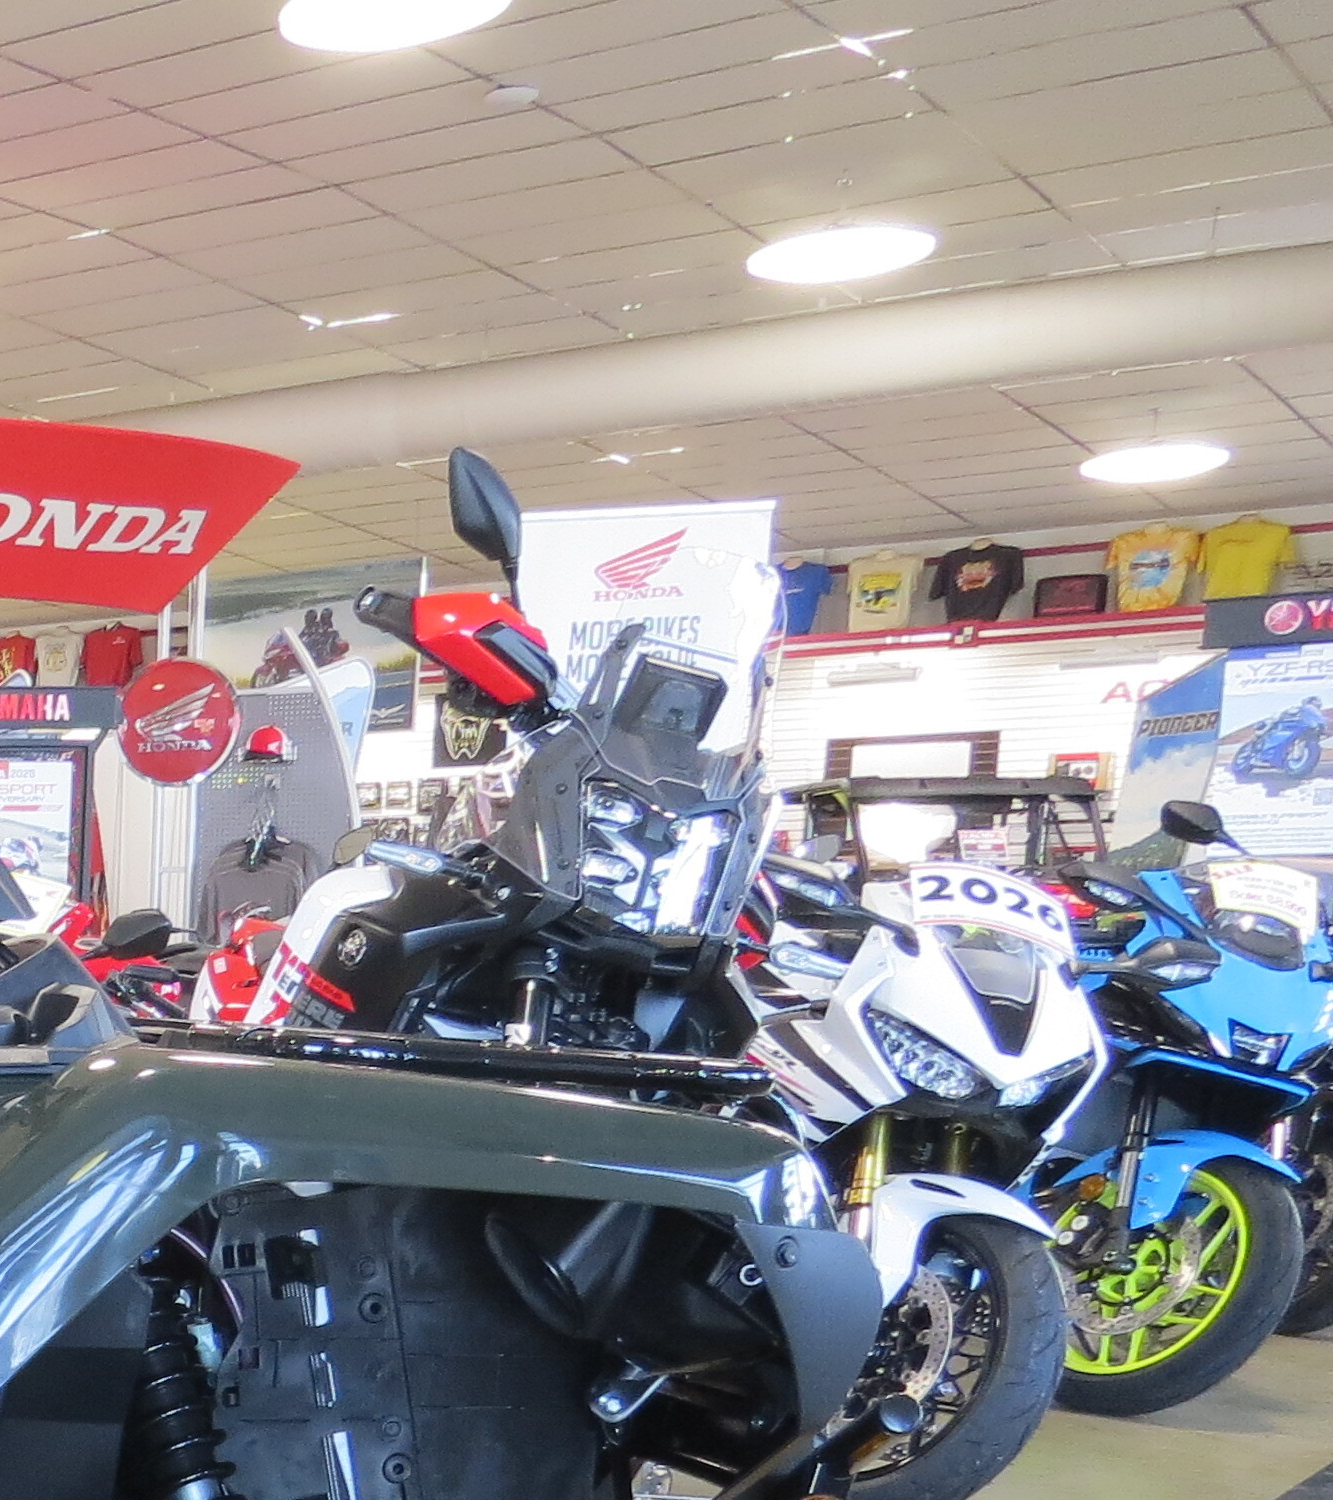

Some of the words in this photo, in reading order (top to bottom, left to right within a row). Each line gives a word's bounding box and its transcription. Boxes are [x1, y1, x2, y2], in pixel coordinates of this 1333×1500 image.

[593, 586, 684, 602] HONDA
[569, 617, 634, 650] MOR
[1137, 711, 1219, 737] PIONEER
[137, 739, 213, 753] HONDA
[918, 875, 1063, 932] 2026
